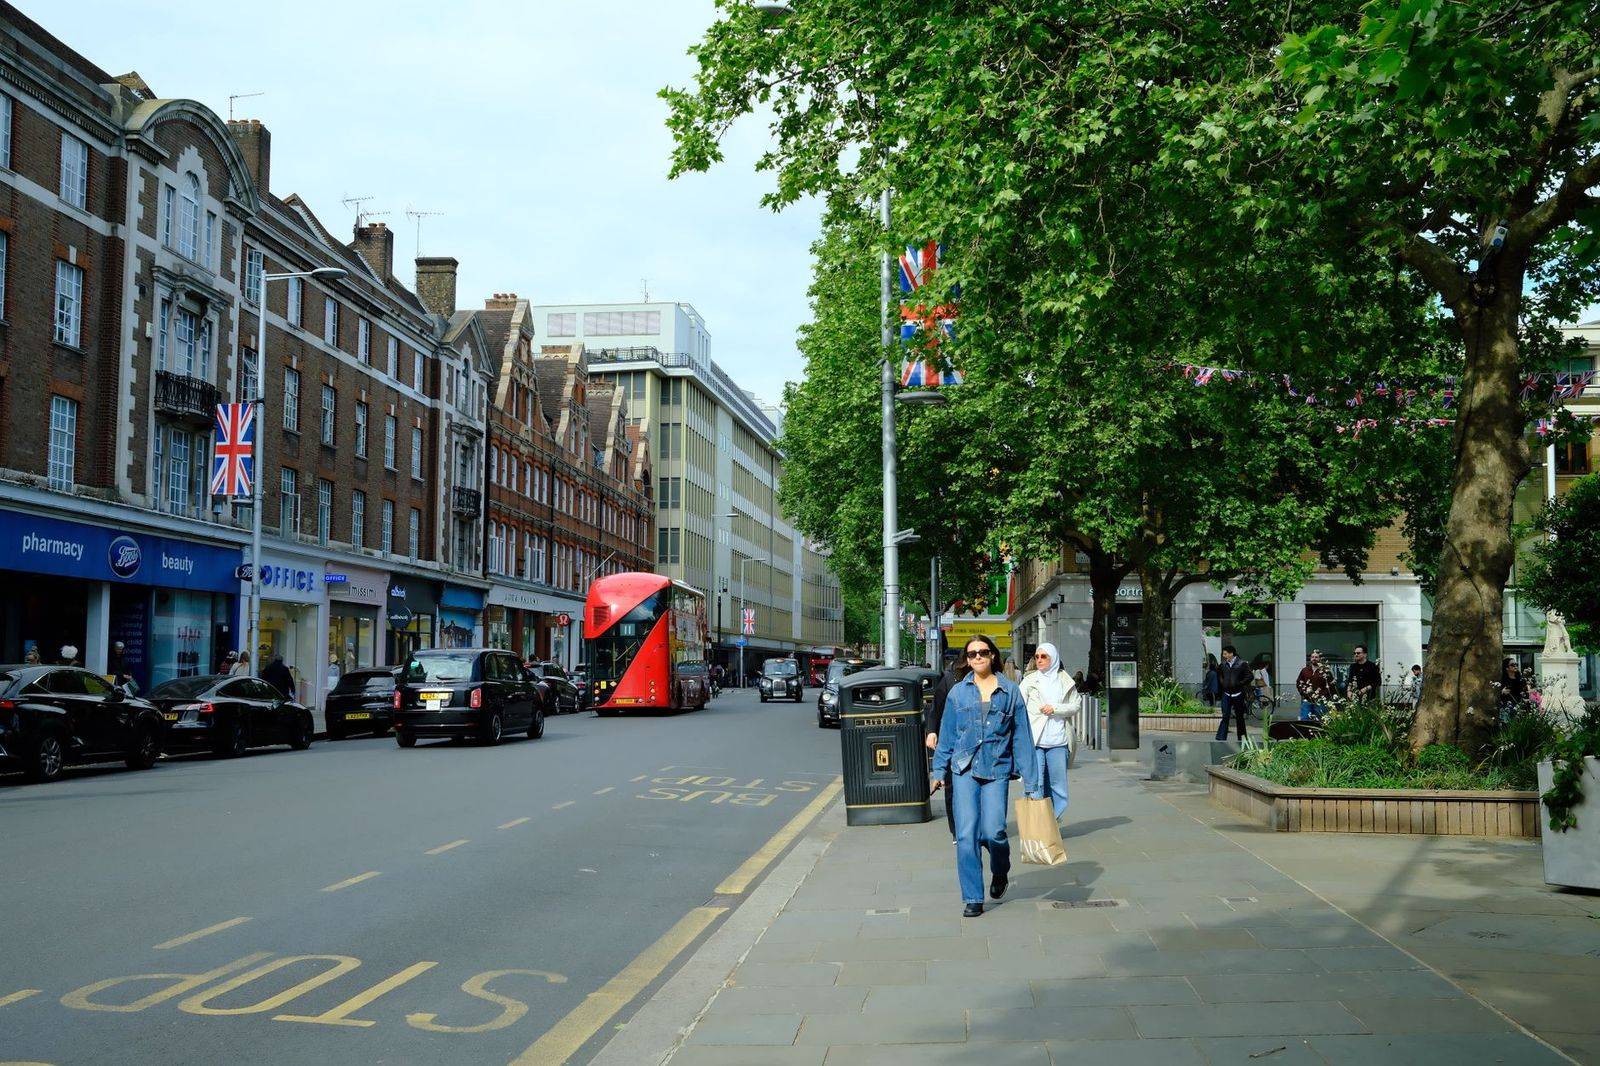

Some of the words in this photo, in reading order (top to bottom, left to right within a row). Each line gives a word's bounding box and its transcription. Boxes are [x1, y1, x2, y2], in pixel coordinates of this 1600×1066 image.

[22, 532, 84, 561] pharmacy
[116, 546, 141, 568] Boots
[162, 552, 194, 575] beauty
[263, 565, 314, 592] OFFICE
[624, 625, 631, 634] 11
[651, 775, 819, 792] STOP
[636, 787, 778, 807] BUS
[60, 952, 568, 1033] STOP
